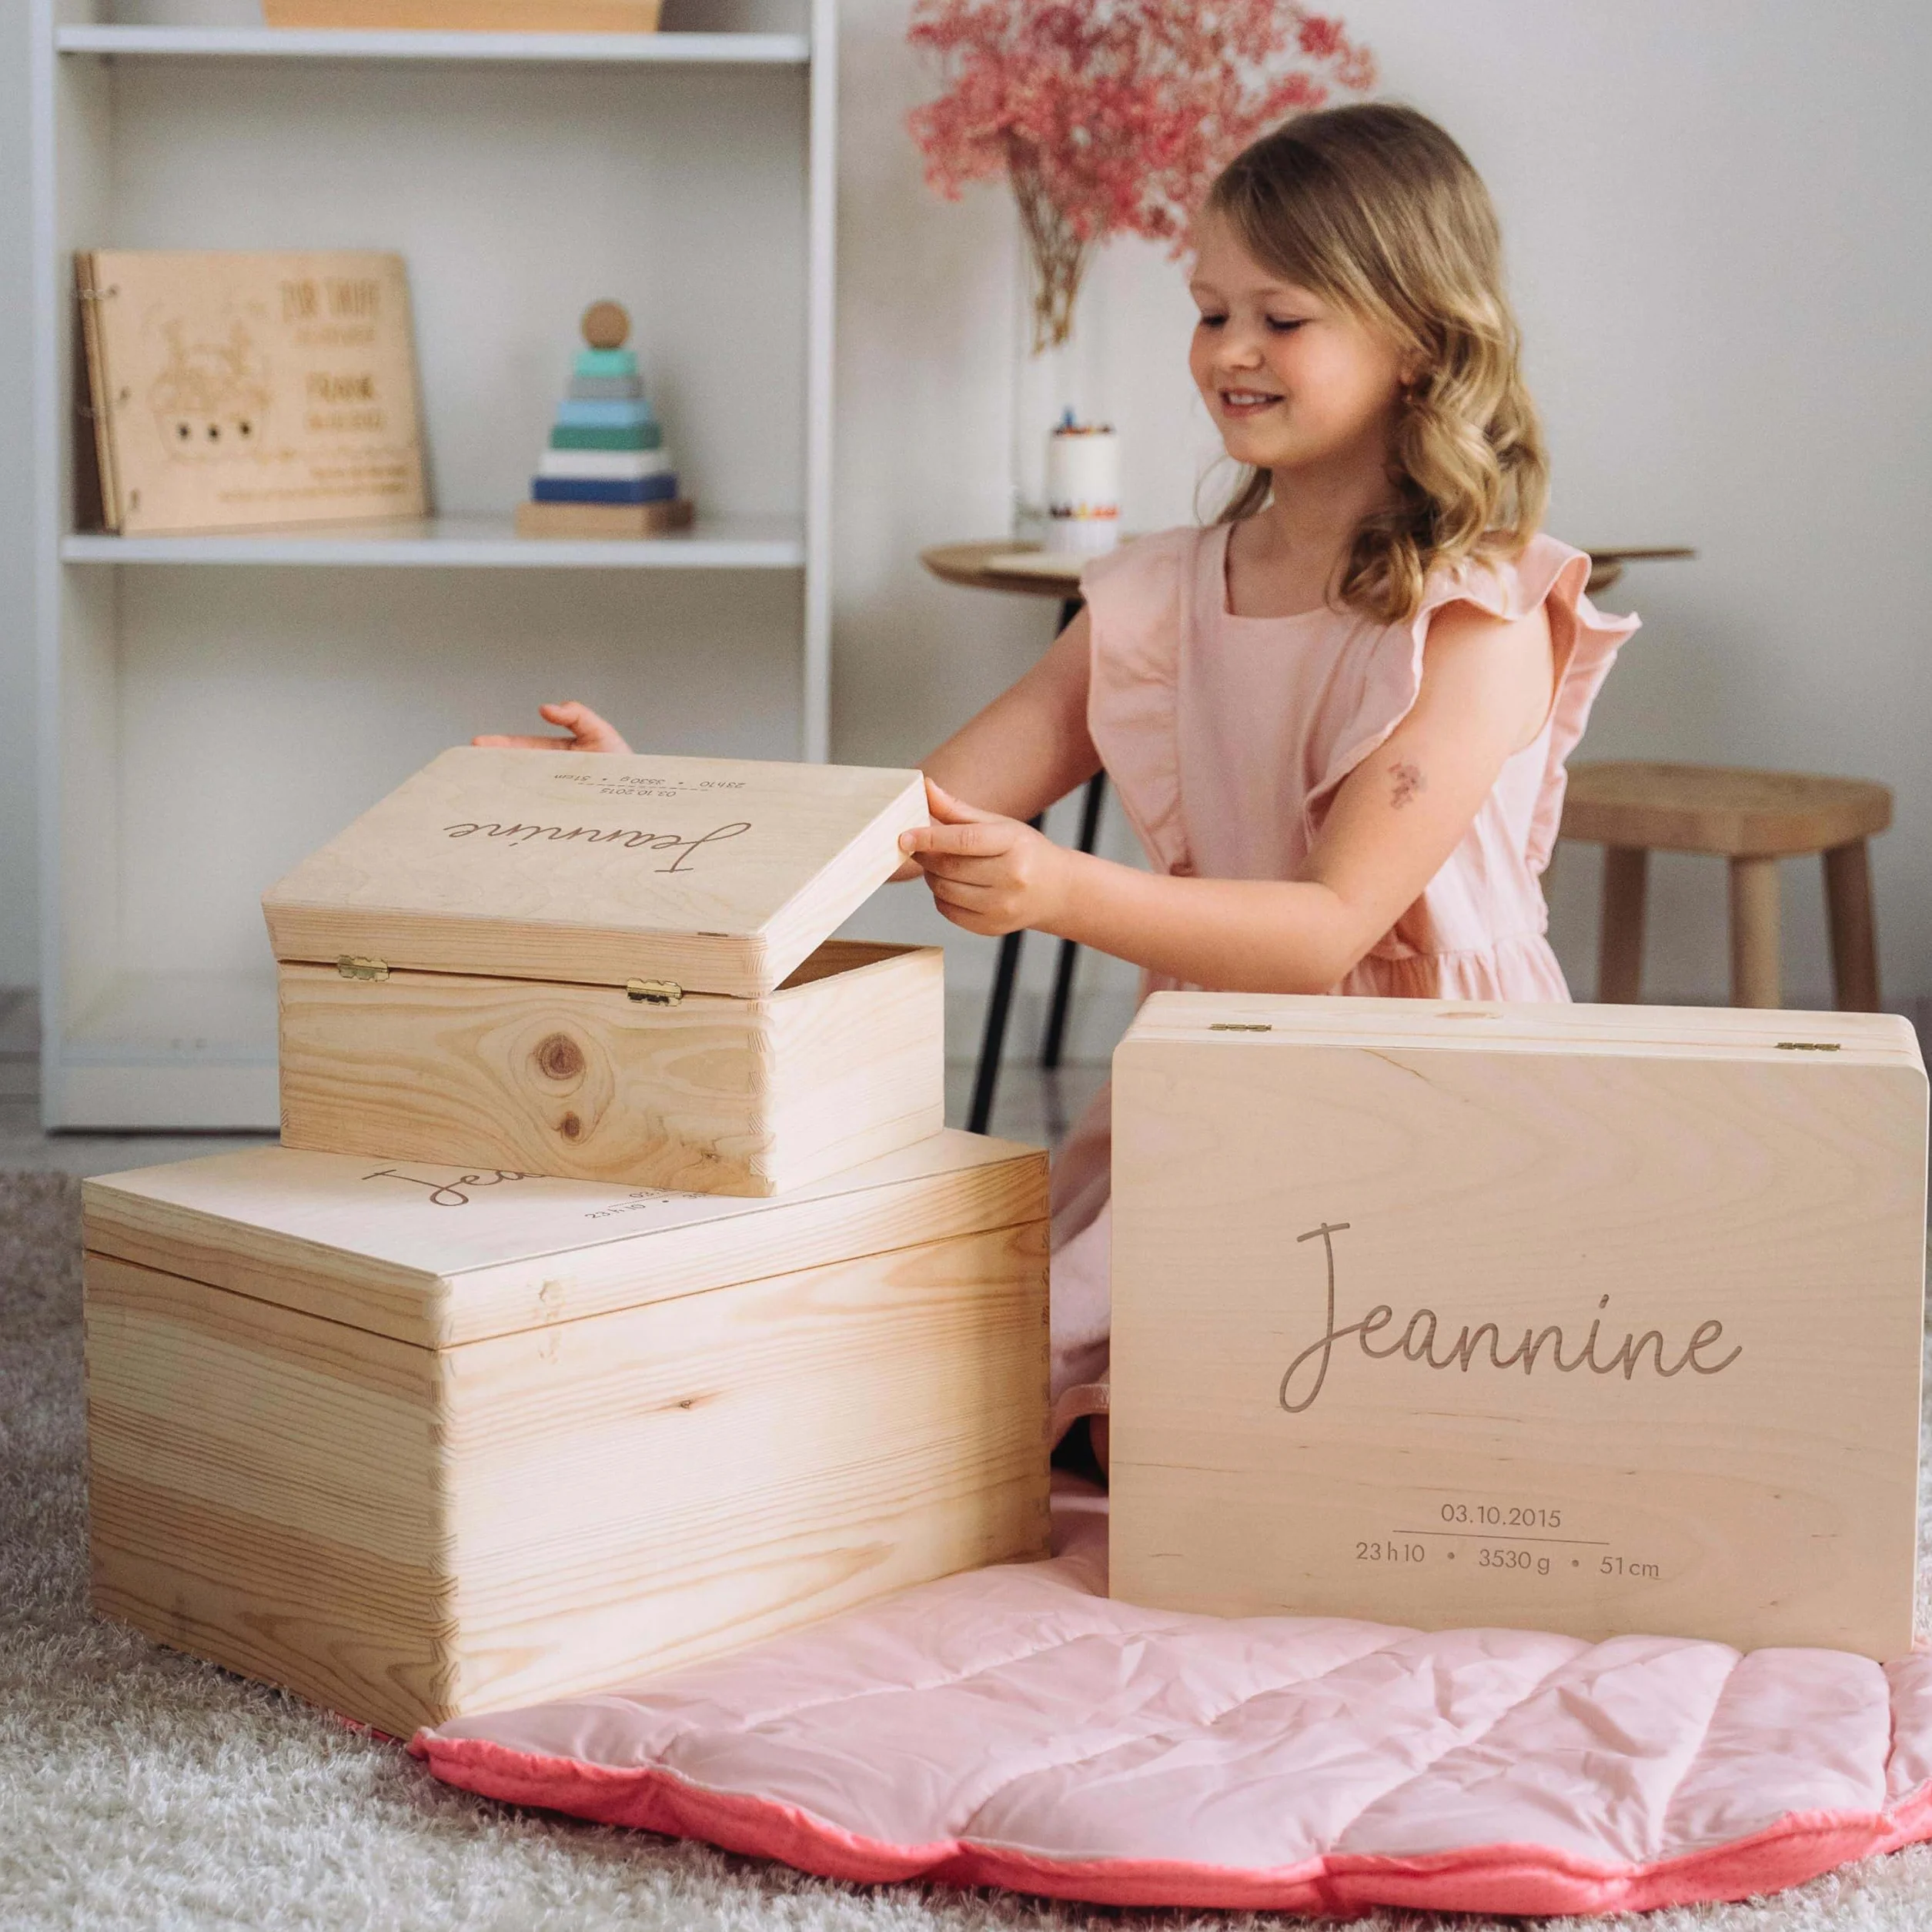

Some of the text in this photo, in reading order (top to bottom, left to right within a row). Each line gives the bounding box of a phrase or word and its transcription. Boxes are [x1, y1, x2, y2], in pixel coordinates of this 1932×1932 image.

[599, 787, 677, 798] 03.10.2015
[443, 821, 752, 873] Jeannine
[362, 1168, 546, 1207] Jea
[1279, 1222, 1743, 1414] Jeannine
[1441, 1503, 1562, 1529] 03.10.2015
